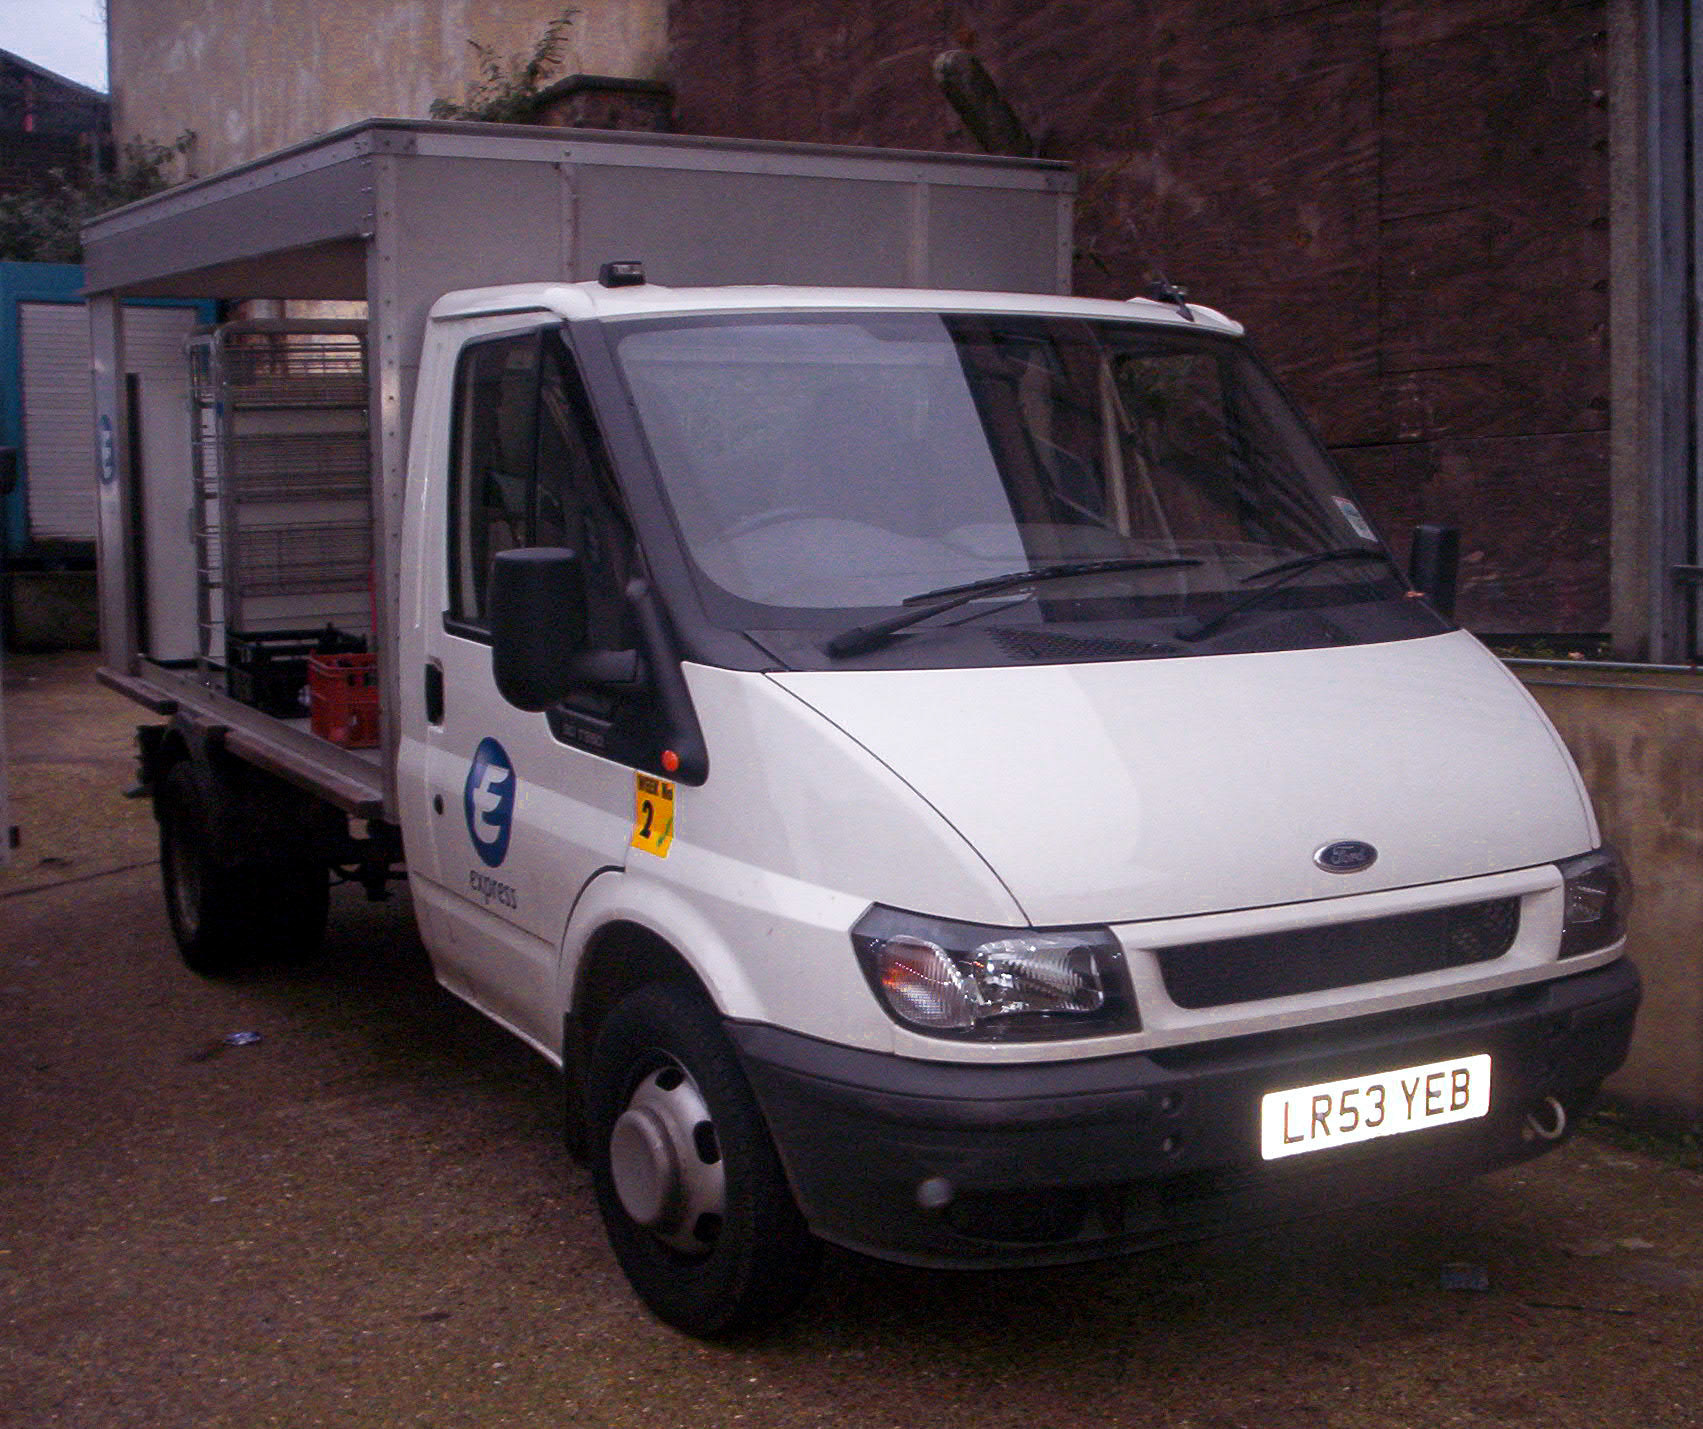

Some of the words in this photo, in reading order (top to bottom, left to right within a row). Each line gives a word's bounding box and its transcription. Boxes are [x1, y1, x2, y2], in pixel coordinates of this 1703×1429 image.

[640, 799, 654, 839] 2
[469, 869, 518, 910] express
[1283, 1084, 1386, 1144] LR53
[1401, 1068, 1470, 1120] YEB
